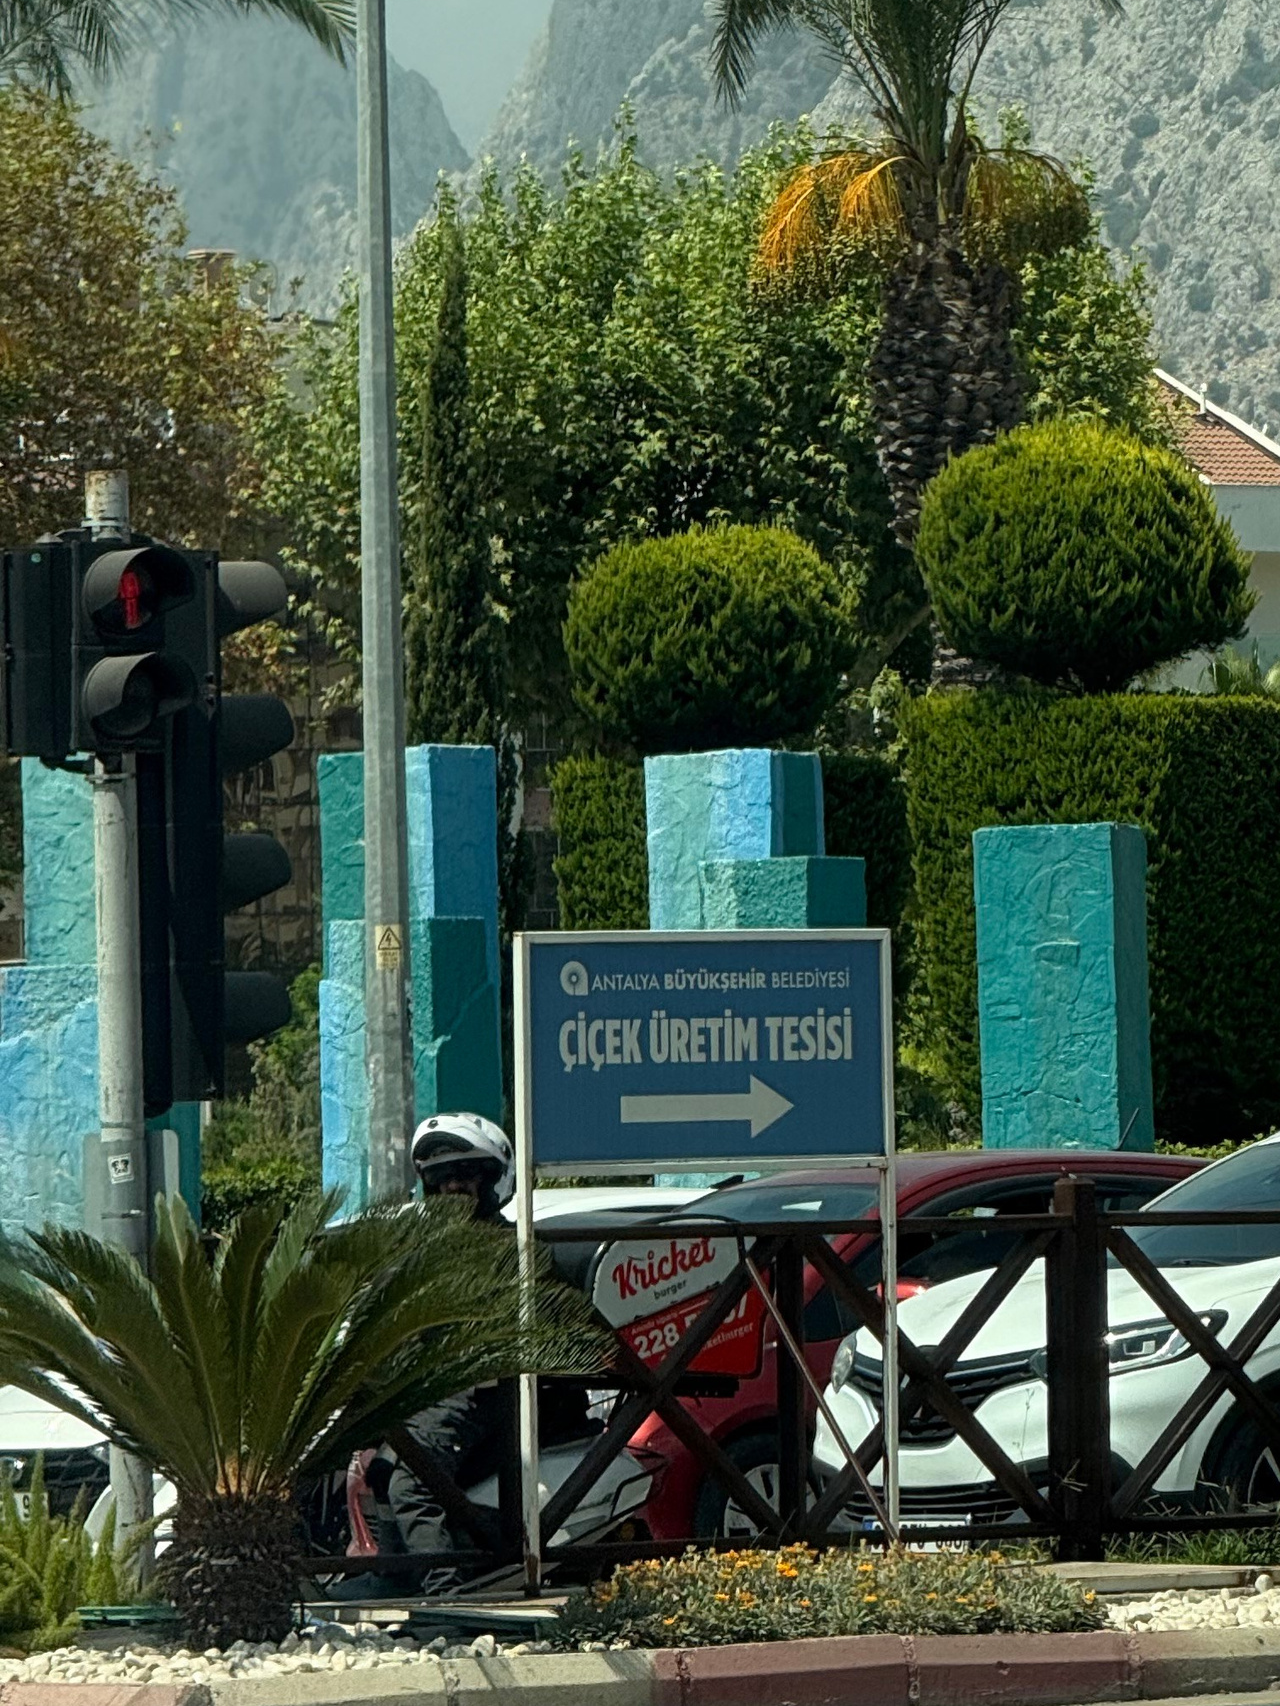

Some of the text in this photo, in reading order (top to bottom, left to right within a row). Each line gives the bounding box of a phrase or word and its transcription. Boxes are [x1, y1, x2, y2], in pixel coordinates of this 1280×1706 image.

[591, 967, 850, 994] ANTALYA BÜYÜKŞEHİR BELEDİYESİ
[558, 1006, 853, 1073] ÇİÇEK ÜRETİM TESİSİ
[611, 1237, 717, 1300] Kricket
[652, 1278, 689, 1301] burger
[633, 1322, 680, 1360] 228
